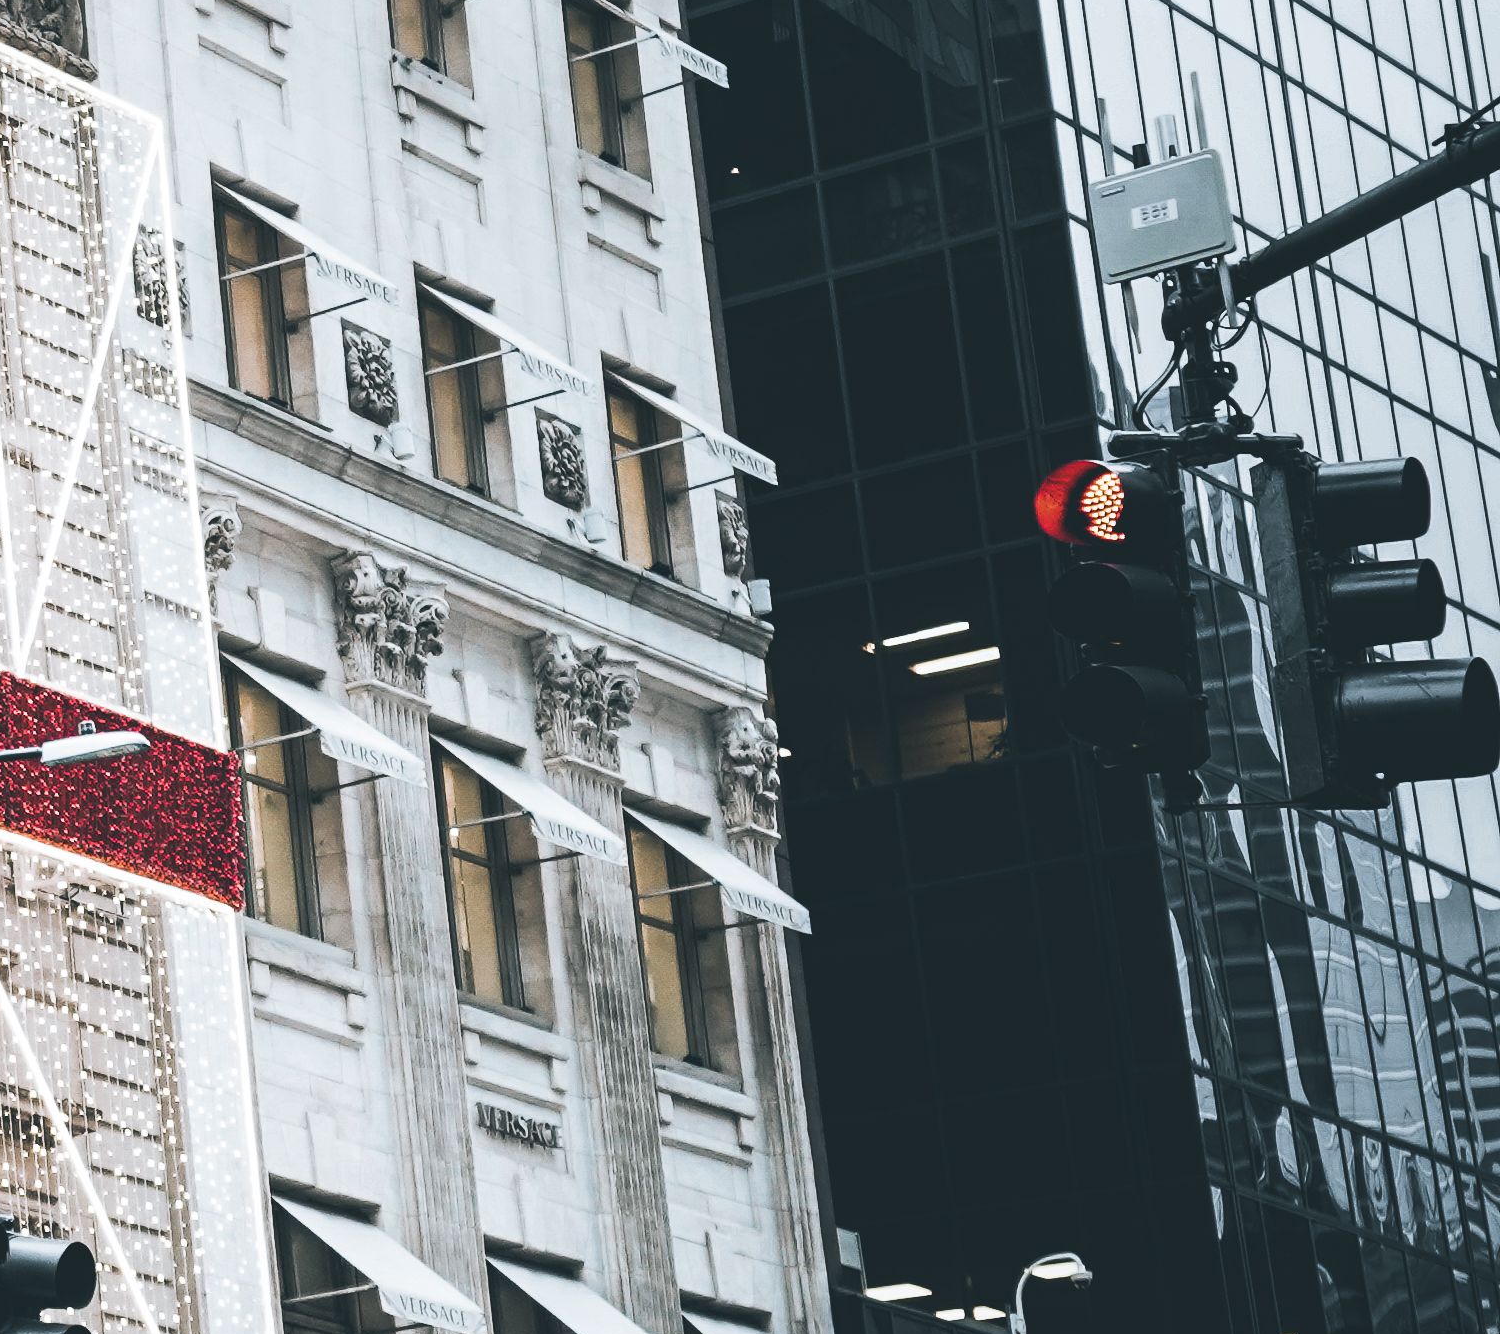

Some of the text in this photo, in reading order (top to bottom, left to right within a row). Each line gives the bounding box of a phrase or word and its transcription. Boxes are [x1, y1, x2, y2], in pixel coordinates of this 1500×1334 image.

[666, 41, 719, 78] VERSACE
[325, 261, 389, 303] VERSACE
[529, 358, 589, 396] VERSACE
[713, 445, 769, 474] VERSACE
[340, 740, 406, 771] VERSACE
[548, 820, 608, 854] VERSACE
[738, 891, 795, 924] VERSACE
[475, 1102, 563, 1149] VERSACE
[400, 1294, 466, 1327] VERSACE
